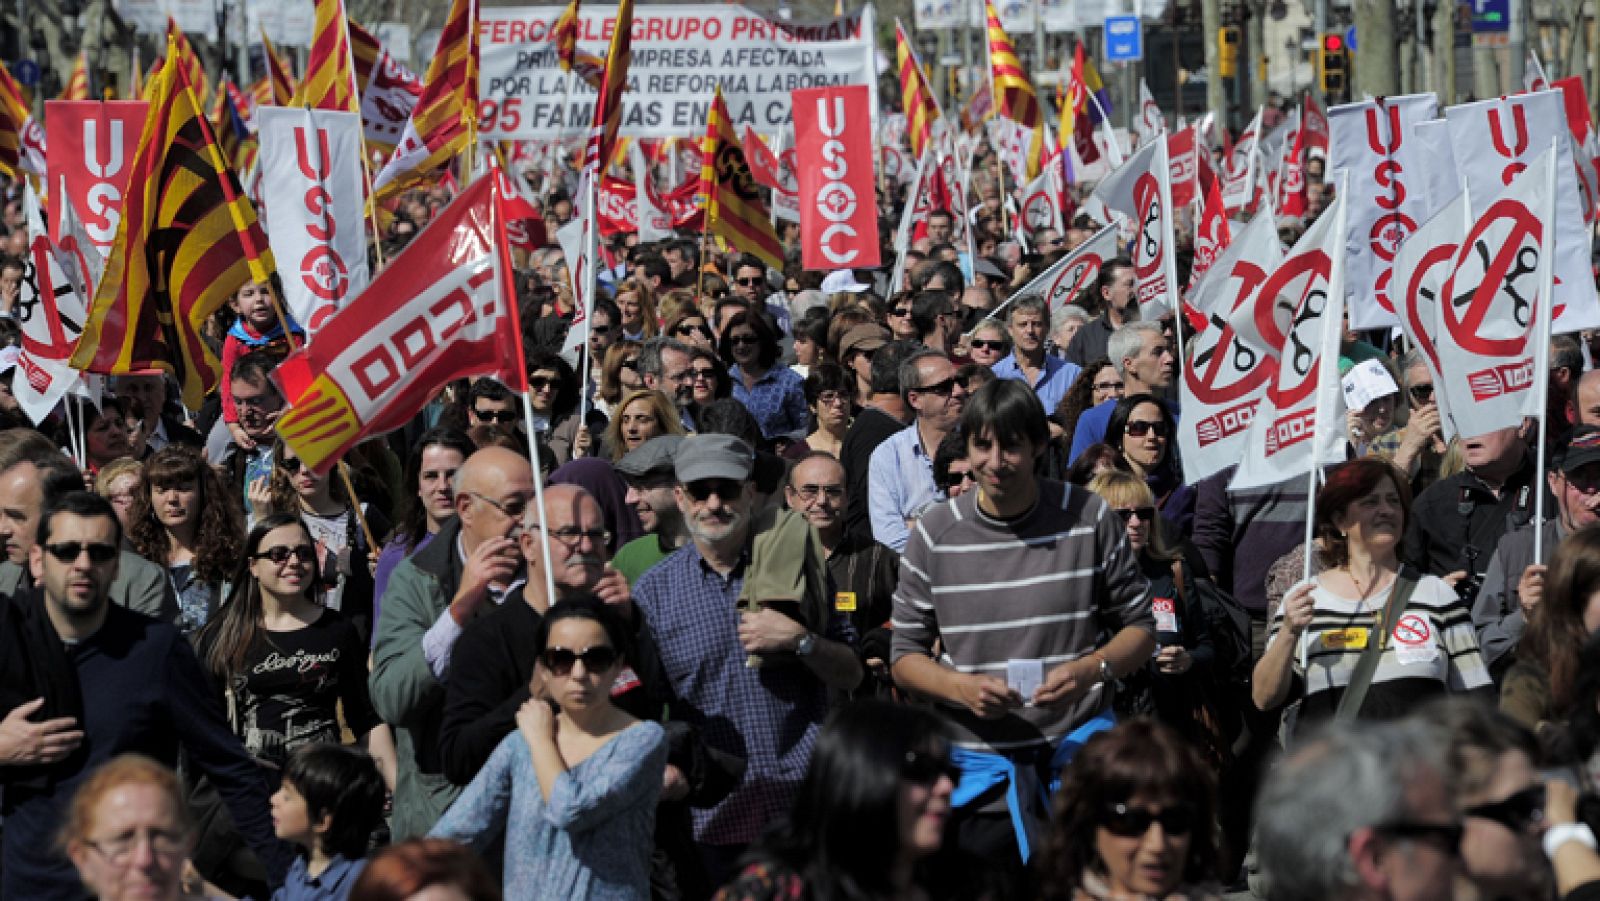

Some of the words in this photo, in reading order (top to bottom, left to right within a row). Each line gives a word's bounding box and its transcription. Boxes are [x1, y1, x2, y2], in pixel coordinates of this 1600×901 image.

[631, 16, 721, 41] GRUPO
[632, 48, 711, 68] MPRESA
[721, 48, 826, 68] AFECTADA
[488, 76, 531, 98] POR
[539, 76, 567, 96] LA
[649, 73, 749, 94] REFORMA
[532, 101, 664, 129] FAMIAS
[673, 101, 708, 126] EN
[728, 101, 757, 126] A
[83, 118, 125, 257] US
[814, 96, 860, 265] USOC
